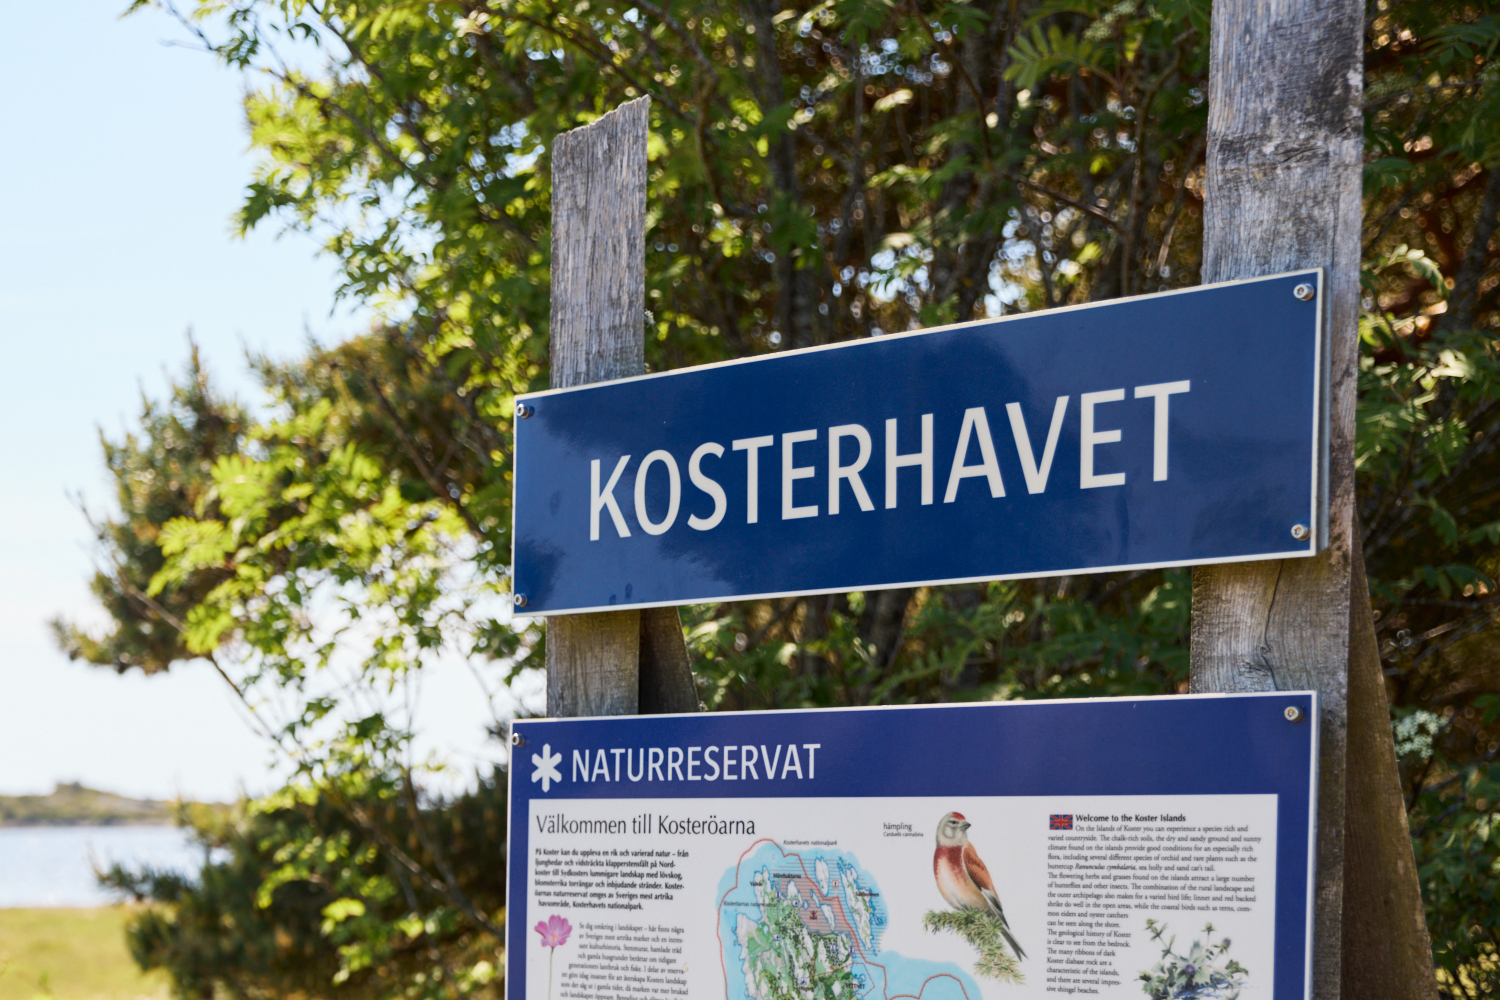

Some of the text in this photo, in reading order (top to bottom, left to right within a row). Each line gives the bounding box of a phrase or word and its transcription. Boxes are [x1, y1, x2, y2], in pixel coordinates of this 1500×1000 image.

[590, 380, 1191, 541] KOSTERHAVET
[572, 743, 821, 783] NATURRESERVAT
[537, 813, 755, 835] Välkommen till Kosteröarna
[883, 822, 912, 832] hämpling
[1166, 825, 1196, 833] experience
[1202, 825, 1223, 833] species
[1065, 834, 1097, 843] countryside.
[1140, 835, 1154, 843] soils,
[1166, 835, 1176, 843] dry
[1189, 835, 1206, 843] sandy
[1207, 835, 1230, 844] ground
[580, 849, 601, 858] uppleva
[605, 859, 649, 868] klapperstensfält
[561, 869, 588, 878] Sydkosters
[590, 870, 619, 879] lummigare
[620, 870, 645, 880] landskap
[659, 871, 682, 880] lövskog,
[568, 879, 594, 888] torrängar
[606, 880, 637, 889] inbjudande
[553, 889, 588, 897] naturreservat
[616, 891, 638, 900] Sveriges
[538, 899, 642, 911] havsområde, Kosterhavets nationalpark.
